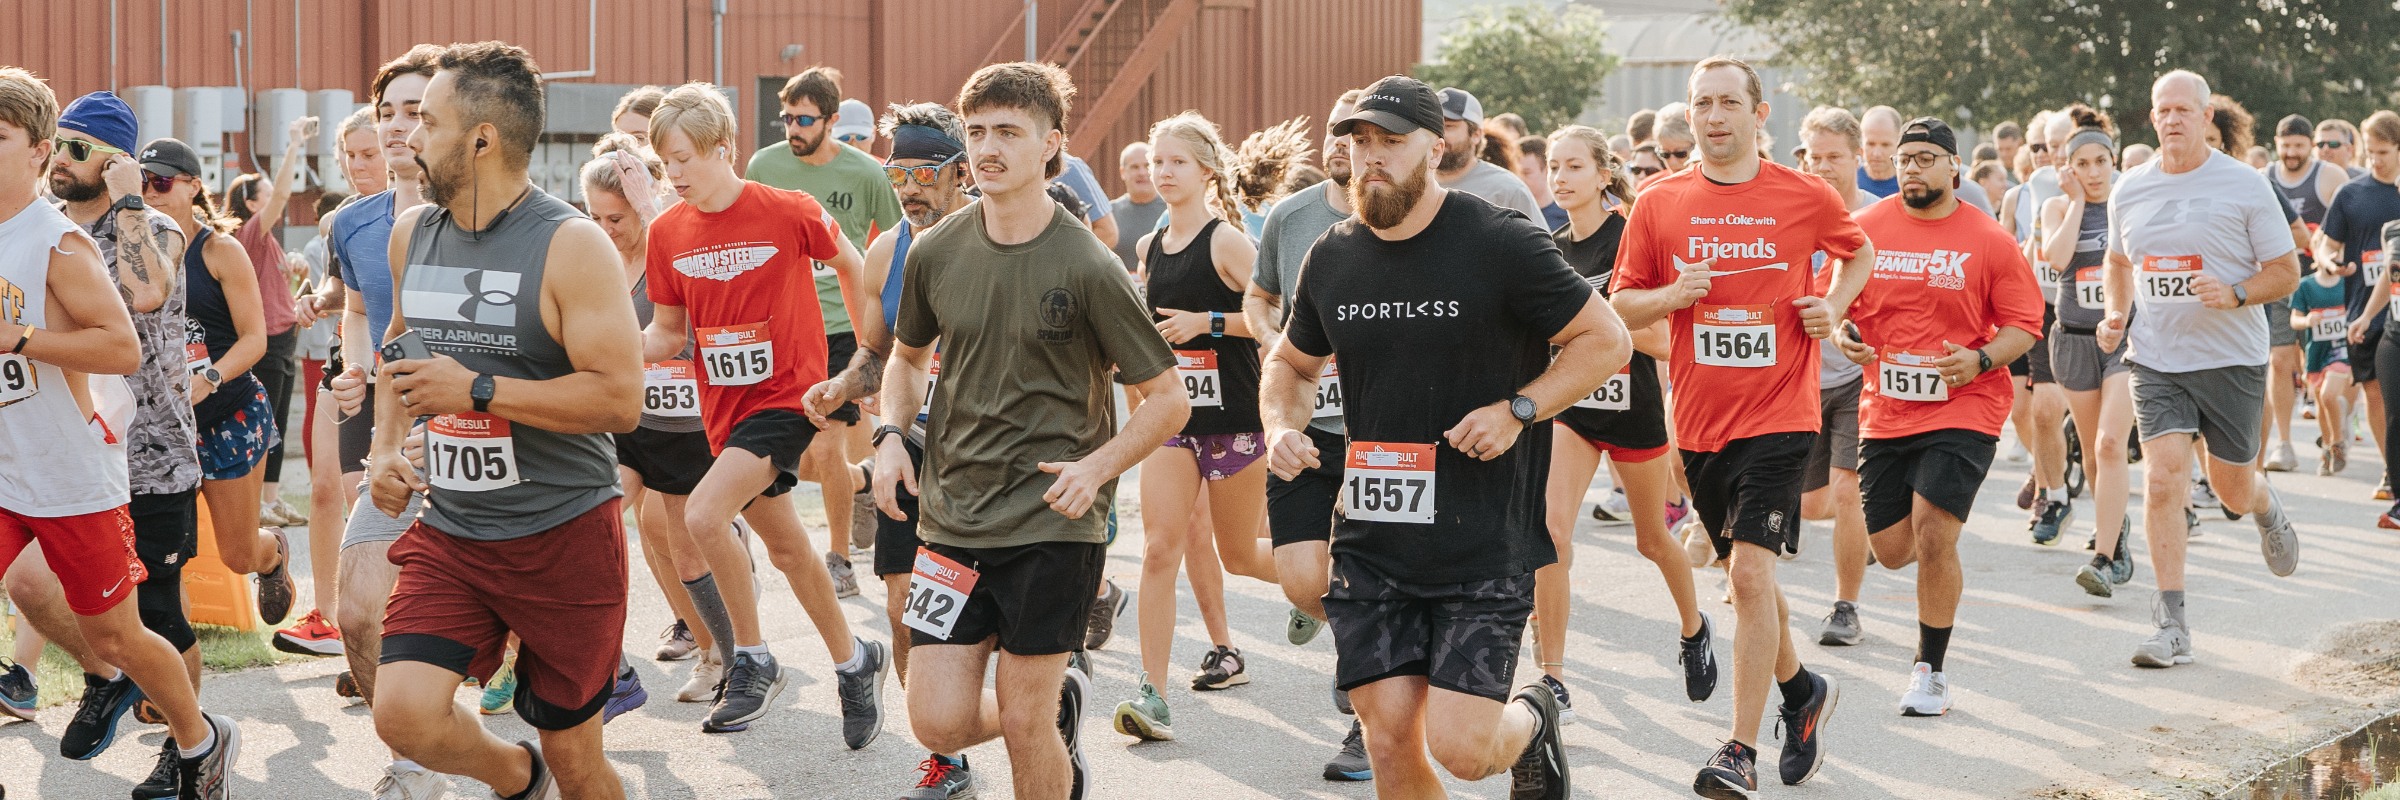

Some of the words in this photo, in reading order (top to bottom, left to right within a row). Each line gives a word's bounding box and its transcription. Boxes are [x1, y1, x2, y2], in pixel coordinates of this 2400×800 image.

[827, 191, 853, 211] 40
[1690, 216, 1716, 225] Share
[1725, 213, 1755, 226] Coke
[1755, 216, 1777, 225] with
[1687, 236, 1777, 259] Friends
[687, 252, 715, 273] MEN
[719, 248, 757, 266] STEEL
[729, 263, 755, 273] WEEKEND
[1873, 255, 1930, 274] FAMILY
[1927, 248, 1972, 279] 5K
[1926, 274, 1966, 291] 2023
[444, 329, 517, 347] ARMOUR
[1700, 331, 1771, 359] 1564
[469, 348, 518, 356] APPAREL
[707, 349, 768, 379] 1615
[1884, 369, 1941, 394] 1517
[457, 418, 491, 430] RESULT
[433, 441, 508, 482] 1705
[1349, 476, 1427, 513] 1557
[937, 565, 961, 581] SULT
